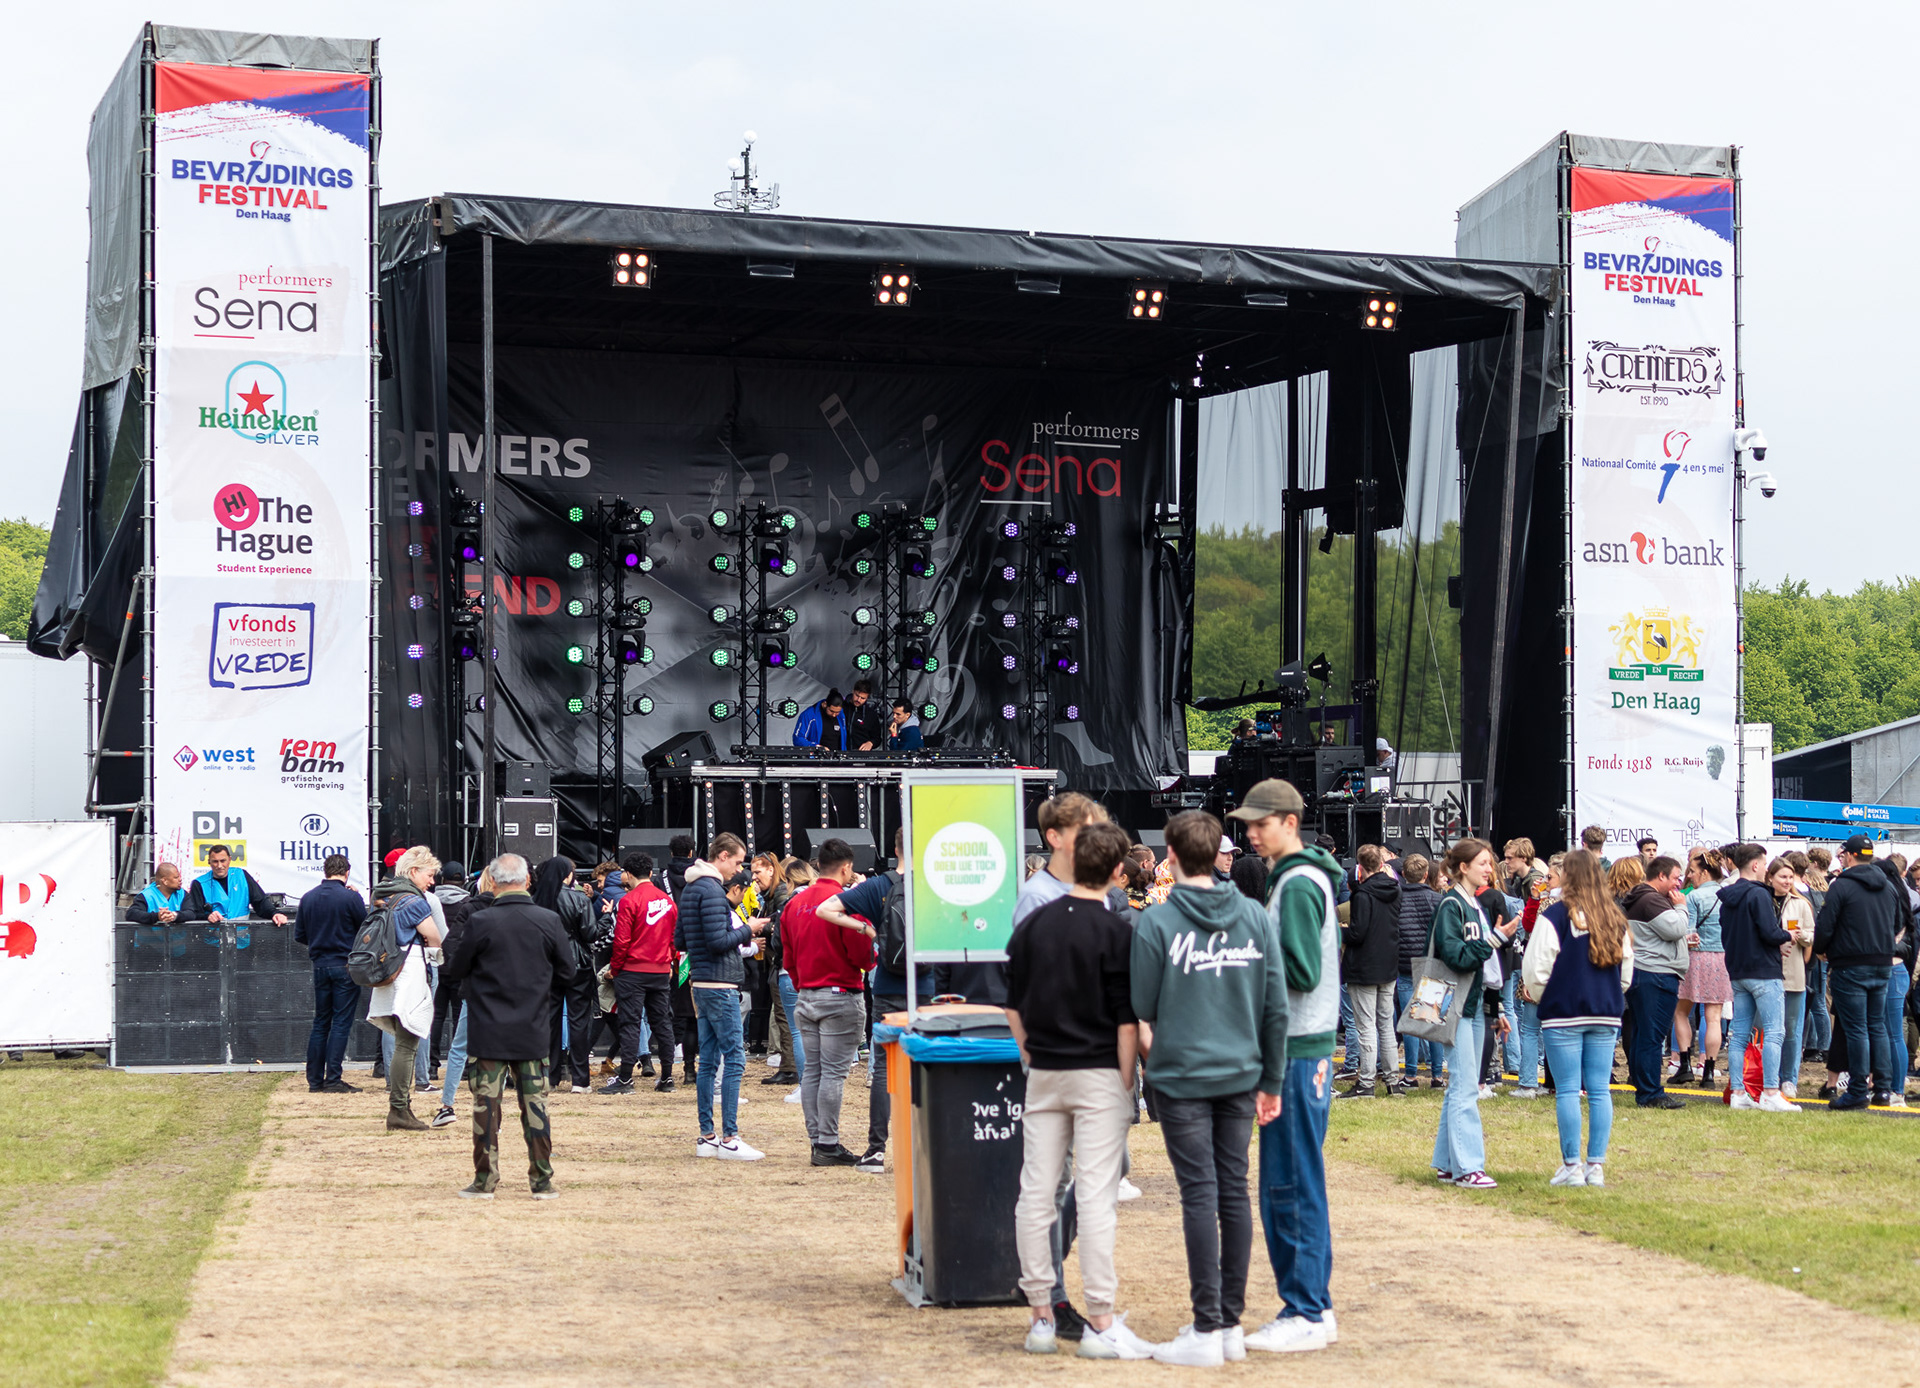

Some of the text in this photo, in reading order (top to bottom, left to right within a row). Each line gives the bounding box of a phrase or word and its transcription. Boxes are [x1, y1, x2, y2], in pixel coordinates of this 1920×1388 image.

[172, 159, 353, 189] BEVRIJDINGS
[199, 184, 327, 210] FESTIVAL
[236, 208, 291, 222] Den Haag
[1584, 252, 1722, 277] BEVRIJDINGS
[239, 265, 332, 290] performers
[1604, 273, 1703, 296] FESTIVAL
[193, 287, 317, 332] Sena
[1633, 295, 1675, 307] Den Haag
[1601, 353, 1707, 383] CREMERS
[1653, 396, 1668, 406] 1990
[198, 407, 318, 431] Heineken
[1032, 411, 1139, 443] performers
[255, 433, 319, 446] SILVER
[980, 439, 1121, 497] Sena
[1582, 457, 1623, 468] Nationaal
[1625, 459, 1656, 470] Comité
[1682, 465, 1688, 473] 4
[1702, 467, 1706, 475] 5
[1708, 464, 1724, 474] mei
[222, 491, 247, 513] HI
[258, 497, 313, 524] The
[216, 527, 313, 560] Hague
[1583, 537, 1725, 566] asn bank
[217, 564, 312, 575] Student Experience
[228, 614, 296, 633] vfonds
[230, 636, 296, 647] investeert in
[216, 653, 306, 675] VREDE
[1614, 670, 1640, 679] VREDE
[1611, 691, 1700, 715] Den Haag
[202, 747, 255, 762] west
[280, 738, 336, 759] rem
[281, 748, 344, 772] bam
[1588, 754, 1622, 770] Fonds
[1627, 756, 1652, 773] 1818
[1664, 757, 1704, 768] R.G. Ruijs
[281, 774, 323, 784] grafische
[294, 782, 344, 790] vormgeving
[280, 840, 350, 860] Hilton
[959, 860, 972, 871] WE
